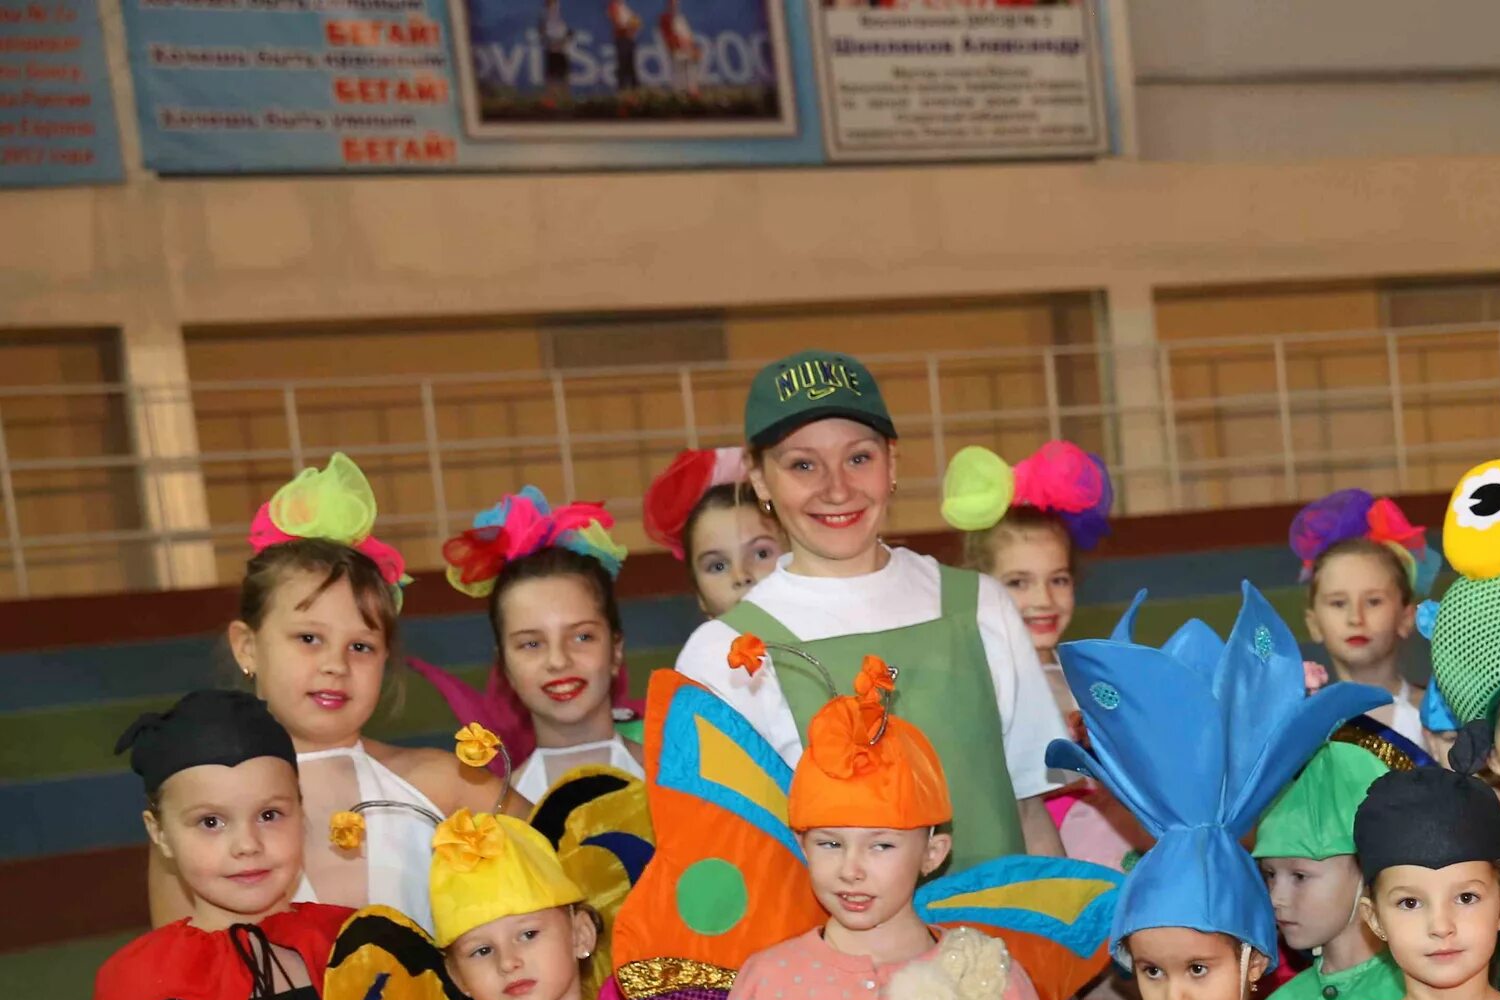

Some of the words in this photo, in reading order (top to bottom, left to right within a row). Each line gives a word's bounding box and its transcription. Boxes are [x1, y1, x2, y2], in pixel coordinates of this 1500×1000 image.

[325, 12, 441, 45] БЕГАЙ!
[333, 71, 449, 104] БЕГАЙ!
[341, 130, 457, 164] БЕГАЙ!
